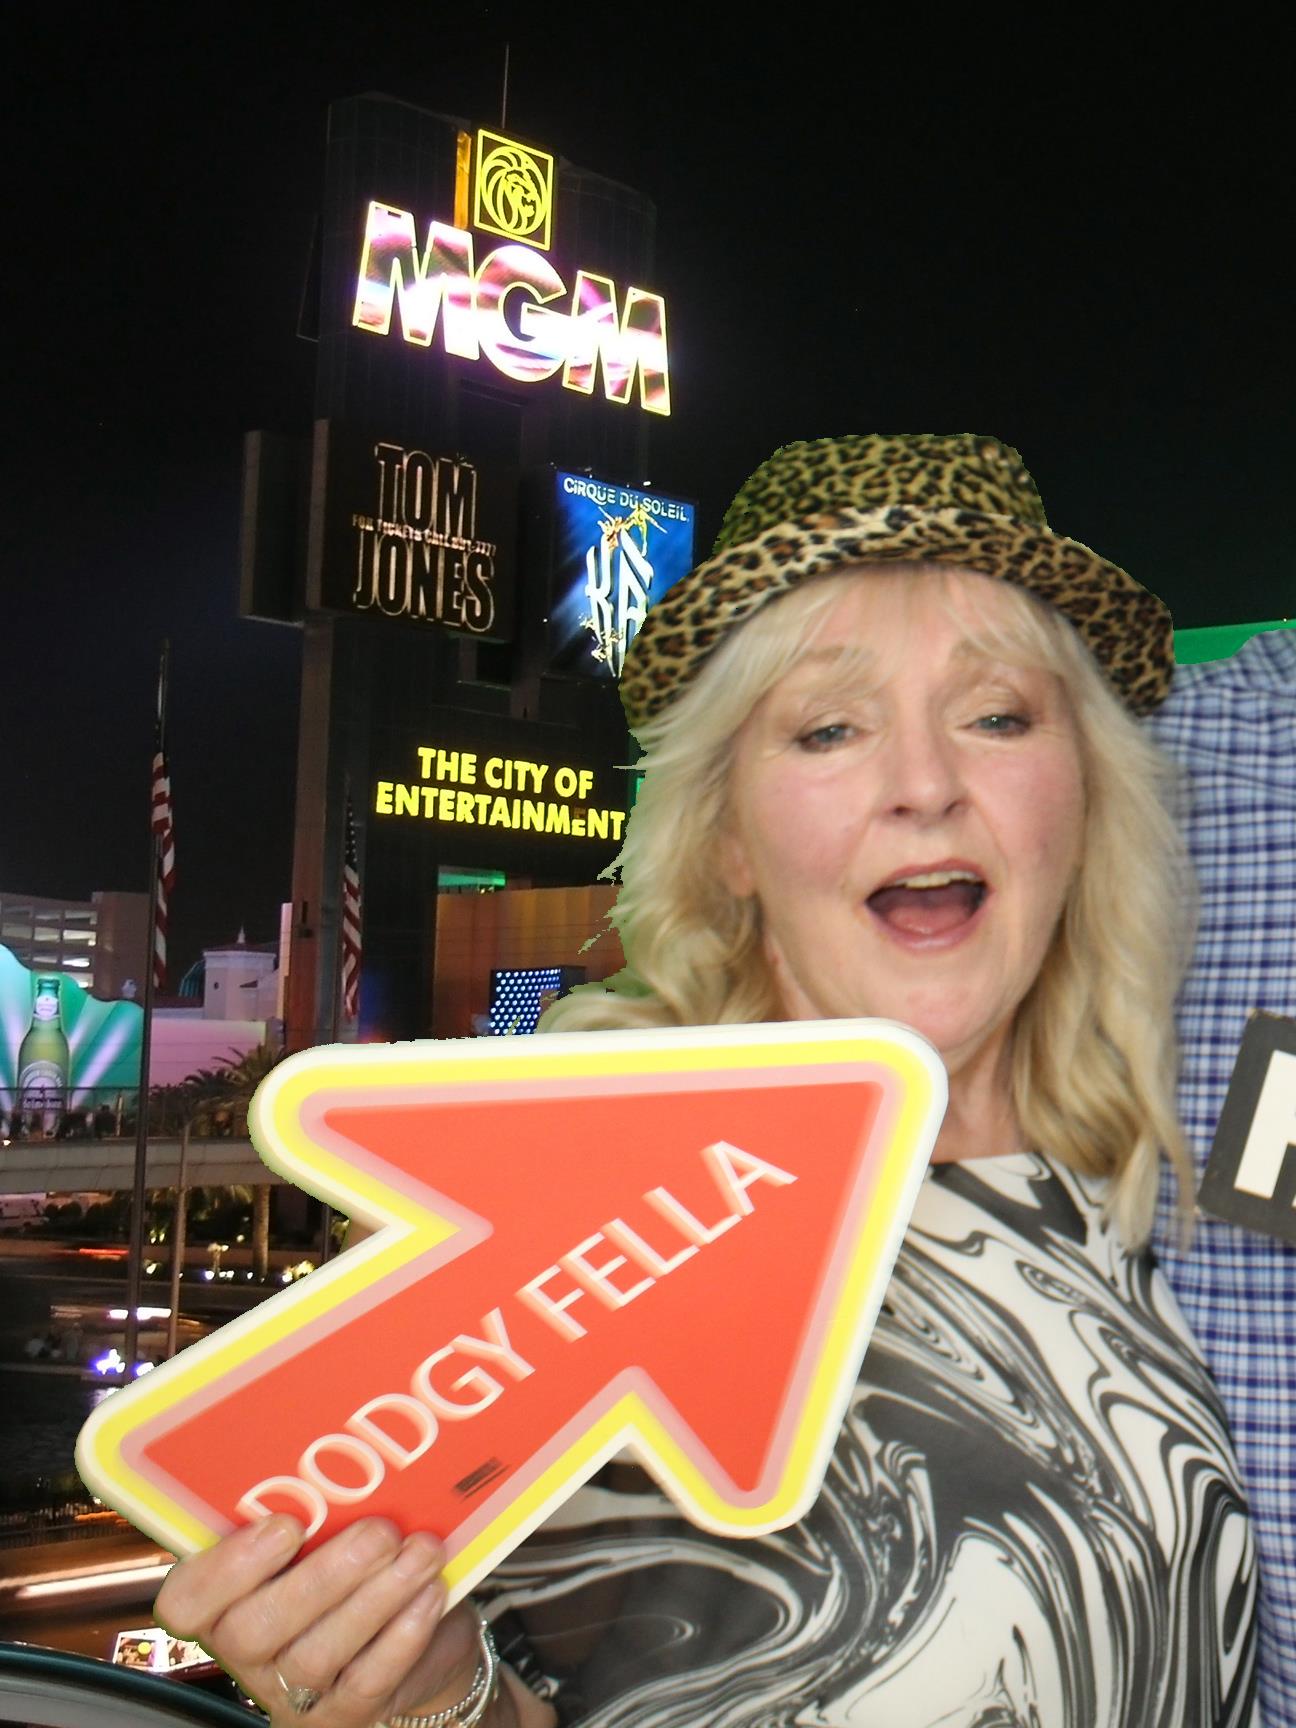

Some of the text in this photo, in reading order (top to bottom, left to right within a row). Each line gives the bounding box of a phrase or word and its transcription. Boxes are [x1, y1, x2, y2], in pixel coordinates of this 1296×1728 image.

[353, 200, 671, 416] MGM
[374, 441, 477, 541] TOM
[353, 531, 495, 632] JONES
[376, 781, 626, 841] ENTERTAINMENT
[417, 746, 595, 800] THE CITY OF
[235, 1140, 798, 1539] DODGY FELLA
